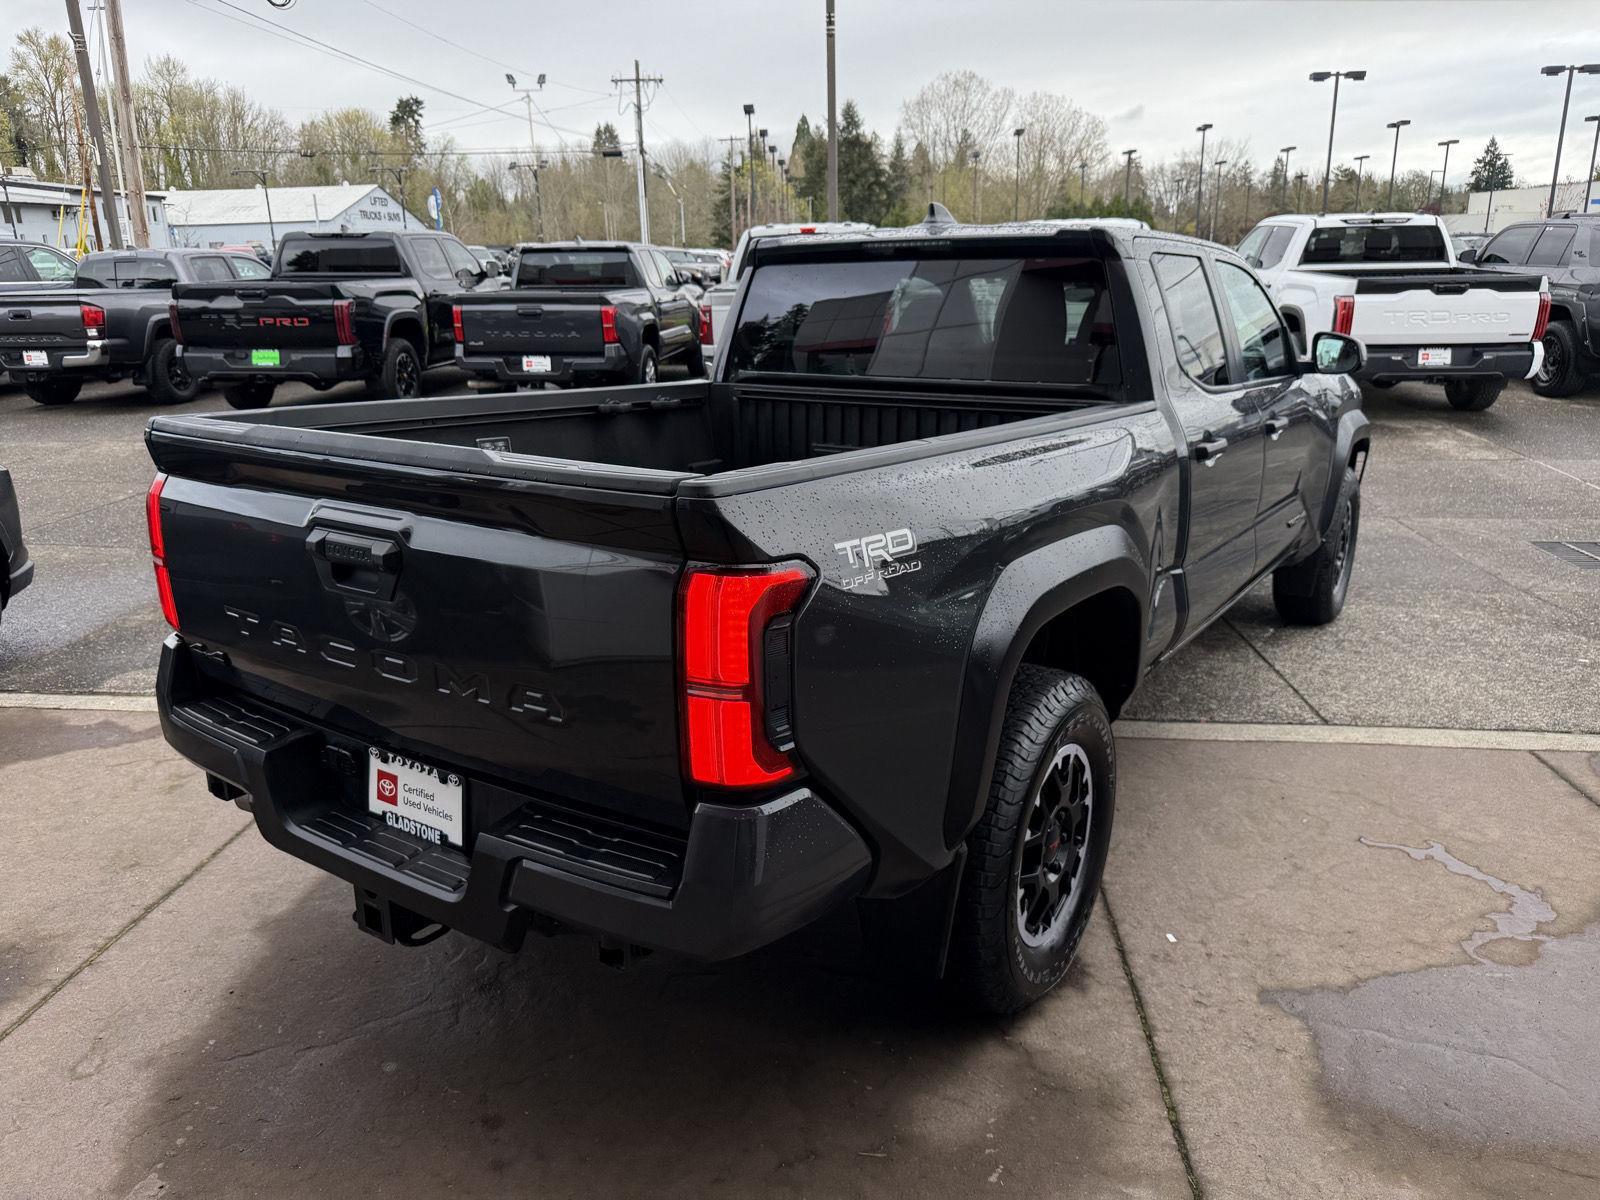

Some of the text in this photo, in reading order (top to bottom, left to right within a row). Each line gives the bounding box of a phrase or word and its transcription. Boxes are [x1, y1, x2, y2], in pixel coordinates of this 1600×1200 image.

[369, 196, 388, 207] LIFTED
[359, 210, 381, 221] TRUCKS
[259, 317, 310, 327] PRO
[1382, 309, 1511, 328] TRD PRO
[485, 330, 580, 338] TACOMA
[834, 528, 917, 570] TRD
[841, 560, 922, 590] OFF ROAD
[223, 605, 566, 723] TACOMA
[387, 752, 440, 779] TOYOTA
[403, 783, 435, 801] Certified
[403, 796, 453, 822] Used Vehicles
[385, 811, 441, 845] GLADSTONE
